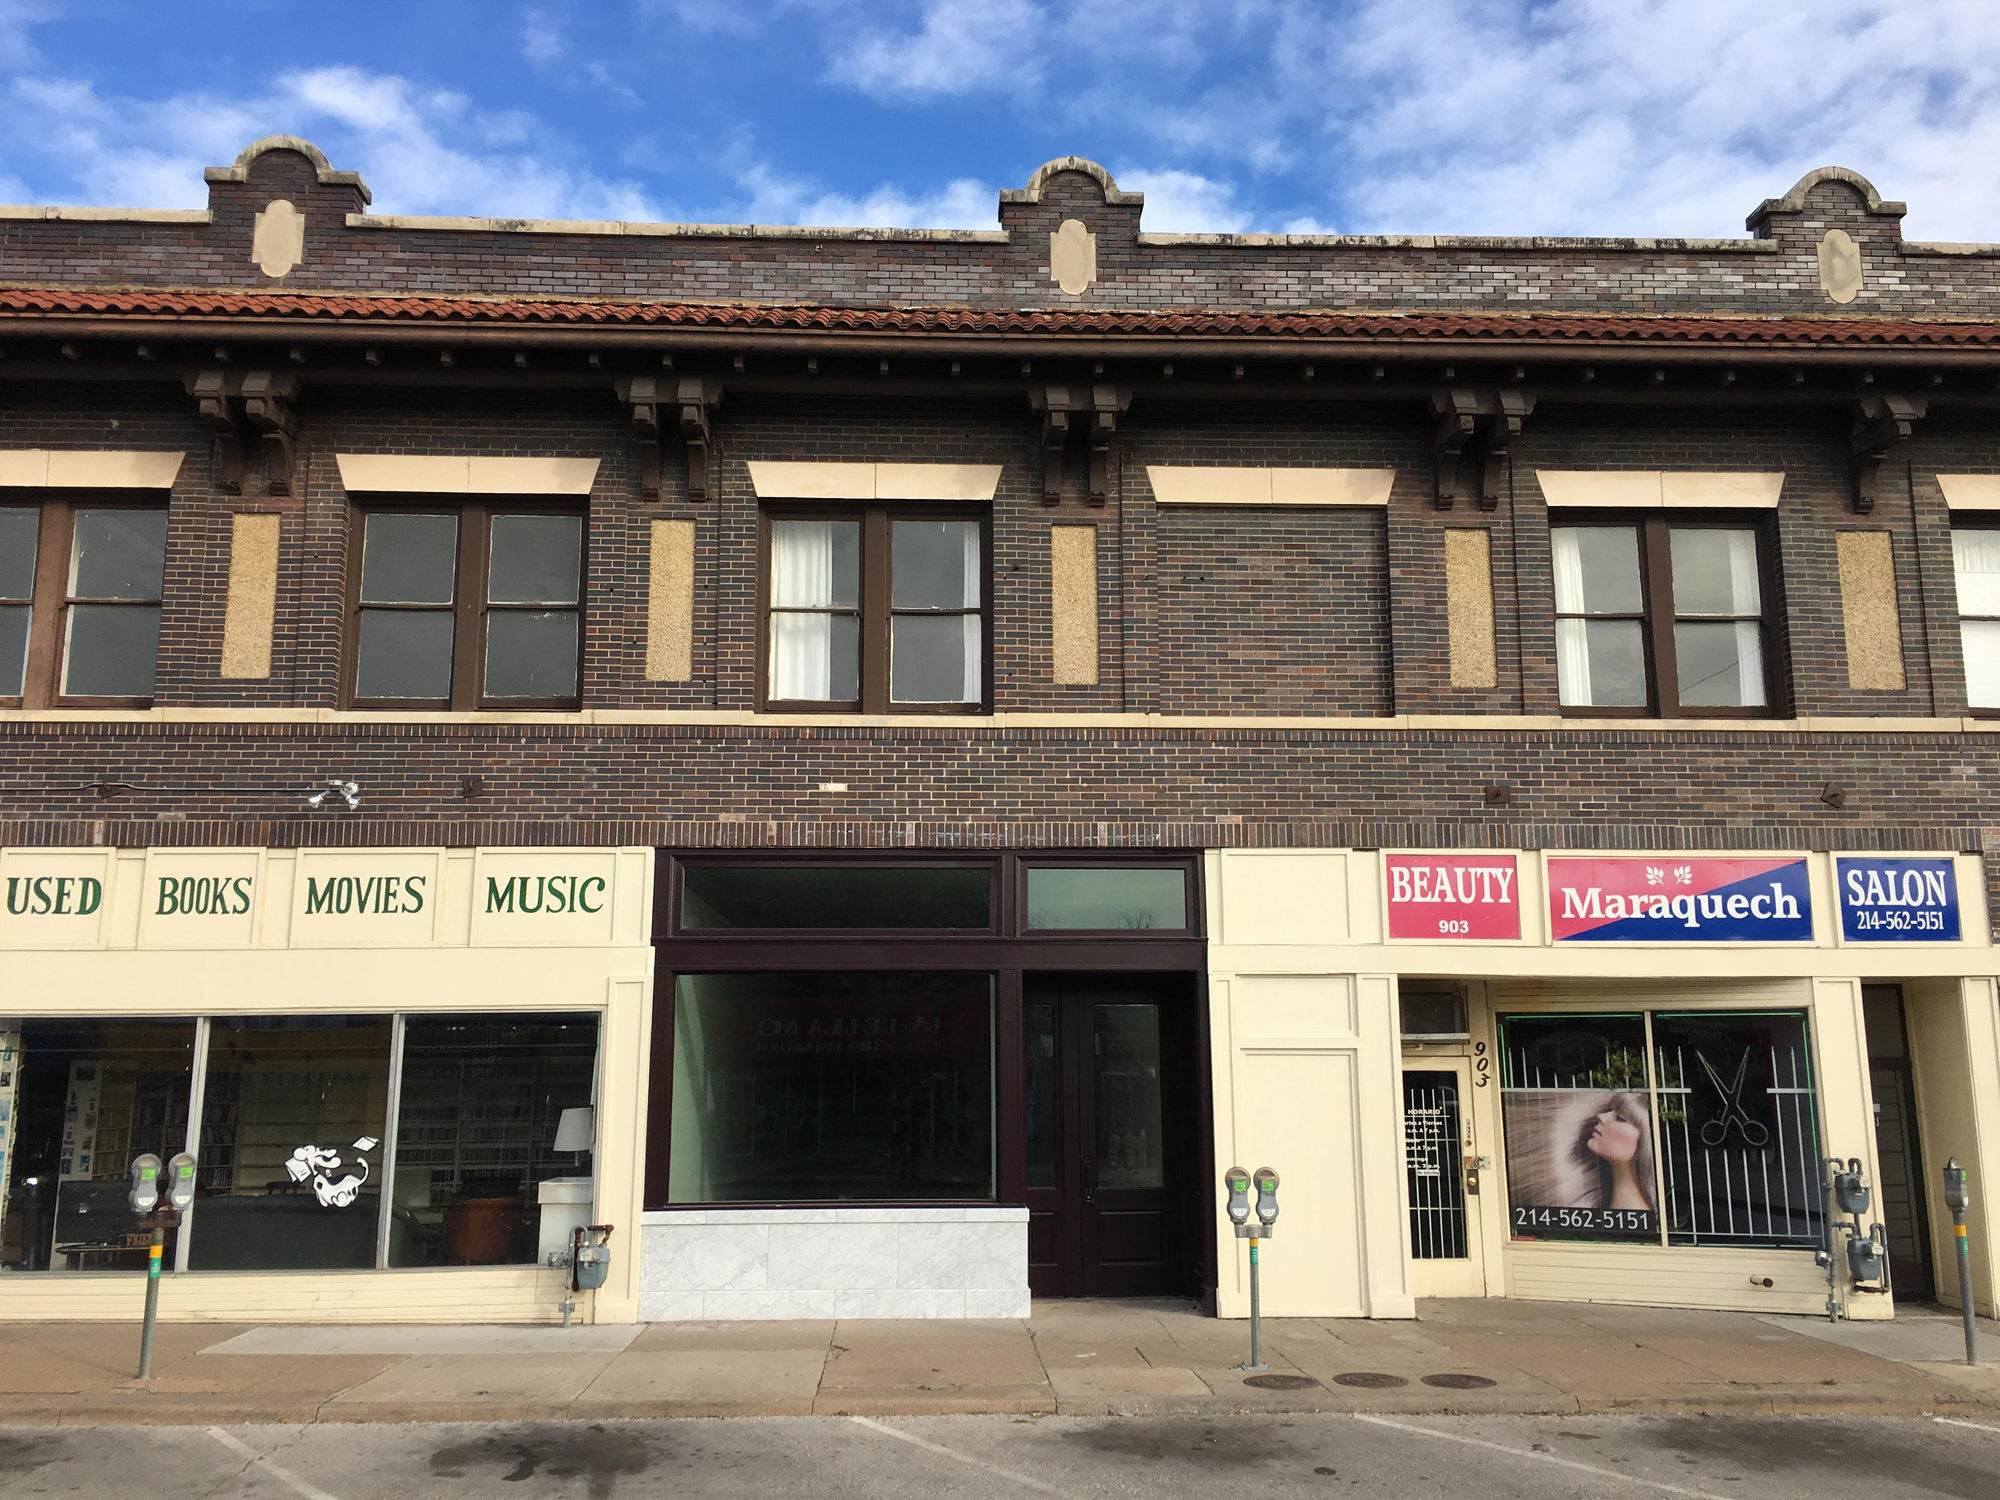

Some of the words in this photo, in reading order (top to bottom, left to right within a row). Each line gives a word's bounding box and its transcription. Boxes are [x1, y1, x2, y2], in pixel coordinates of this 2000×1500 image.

[7, 876, 102, 915] USED
[155, 876, 252, 915] BOOKS
[304, 876, 427, 915] MOVIES
[485, 876, 606, 914] MUSIC
[1390, 866, 1514, 904] BEAUTY
[1847, 869, 1948, 907] SALON
[1561, 882, 1802, 928] Maraquech
[1857, 911, 1944, 930] 214-562-5151
[1438, 919, 1470, 934] 903
[1474, 1041, 1491, 1088] 903
[1516, 1207, 1648, 1230] 214-562-5151
